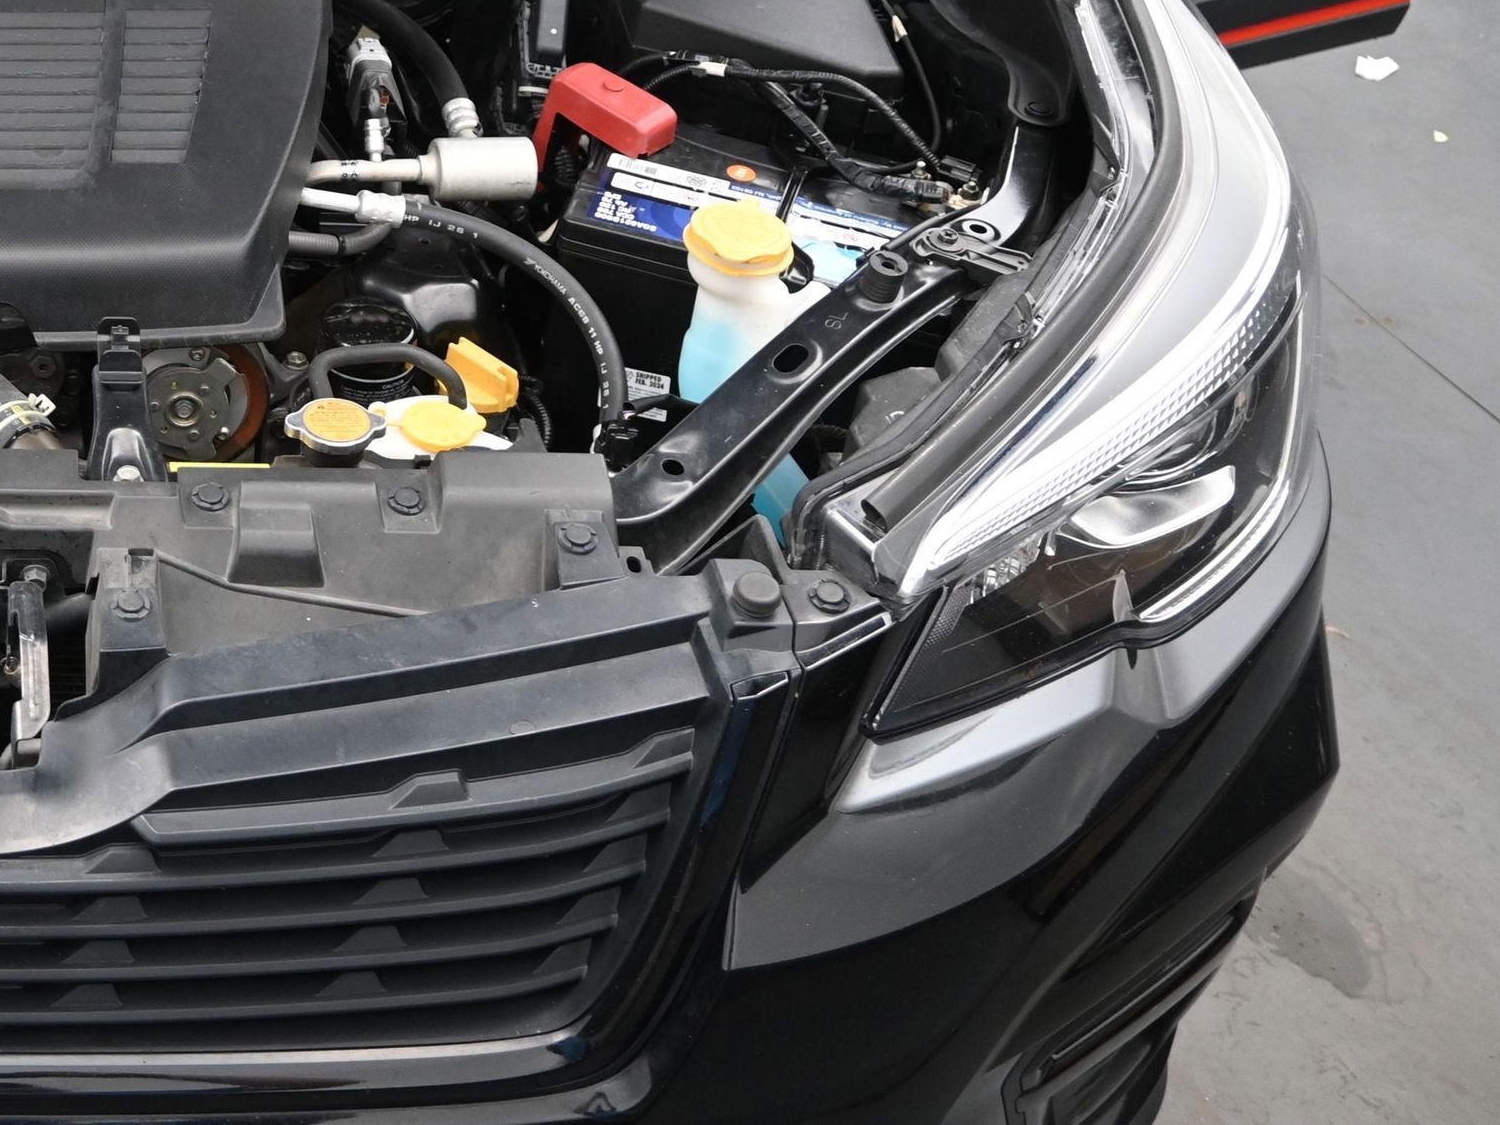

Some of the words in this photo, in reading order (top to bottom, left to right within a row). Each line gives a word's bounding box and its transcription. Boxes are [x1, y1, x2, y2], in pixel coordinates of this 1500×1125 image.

[824, 312, 848, 330] SL
[588, 327, 597, 339] 11
[594, 340, 604, 355] HP
[636, 371, 662, 382] SHIPPED
